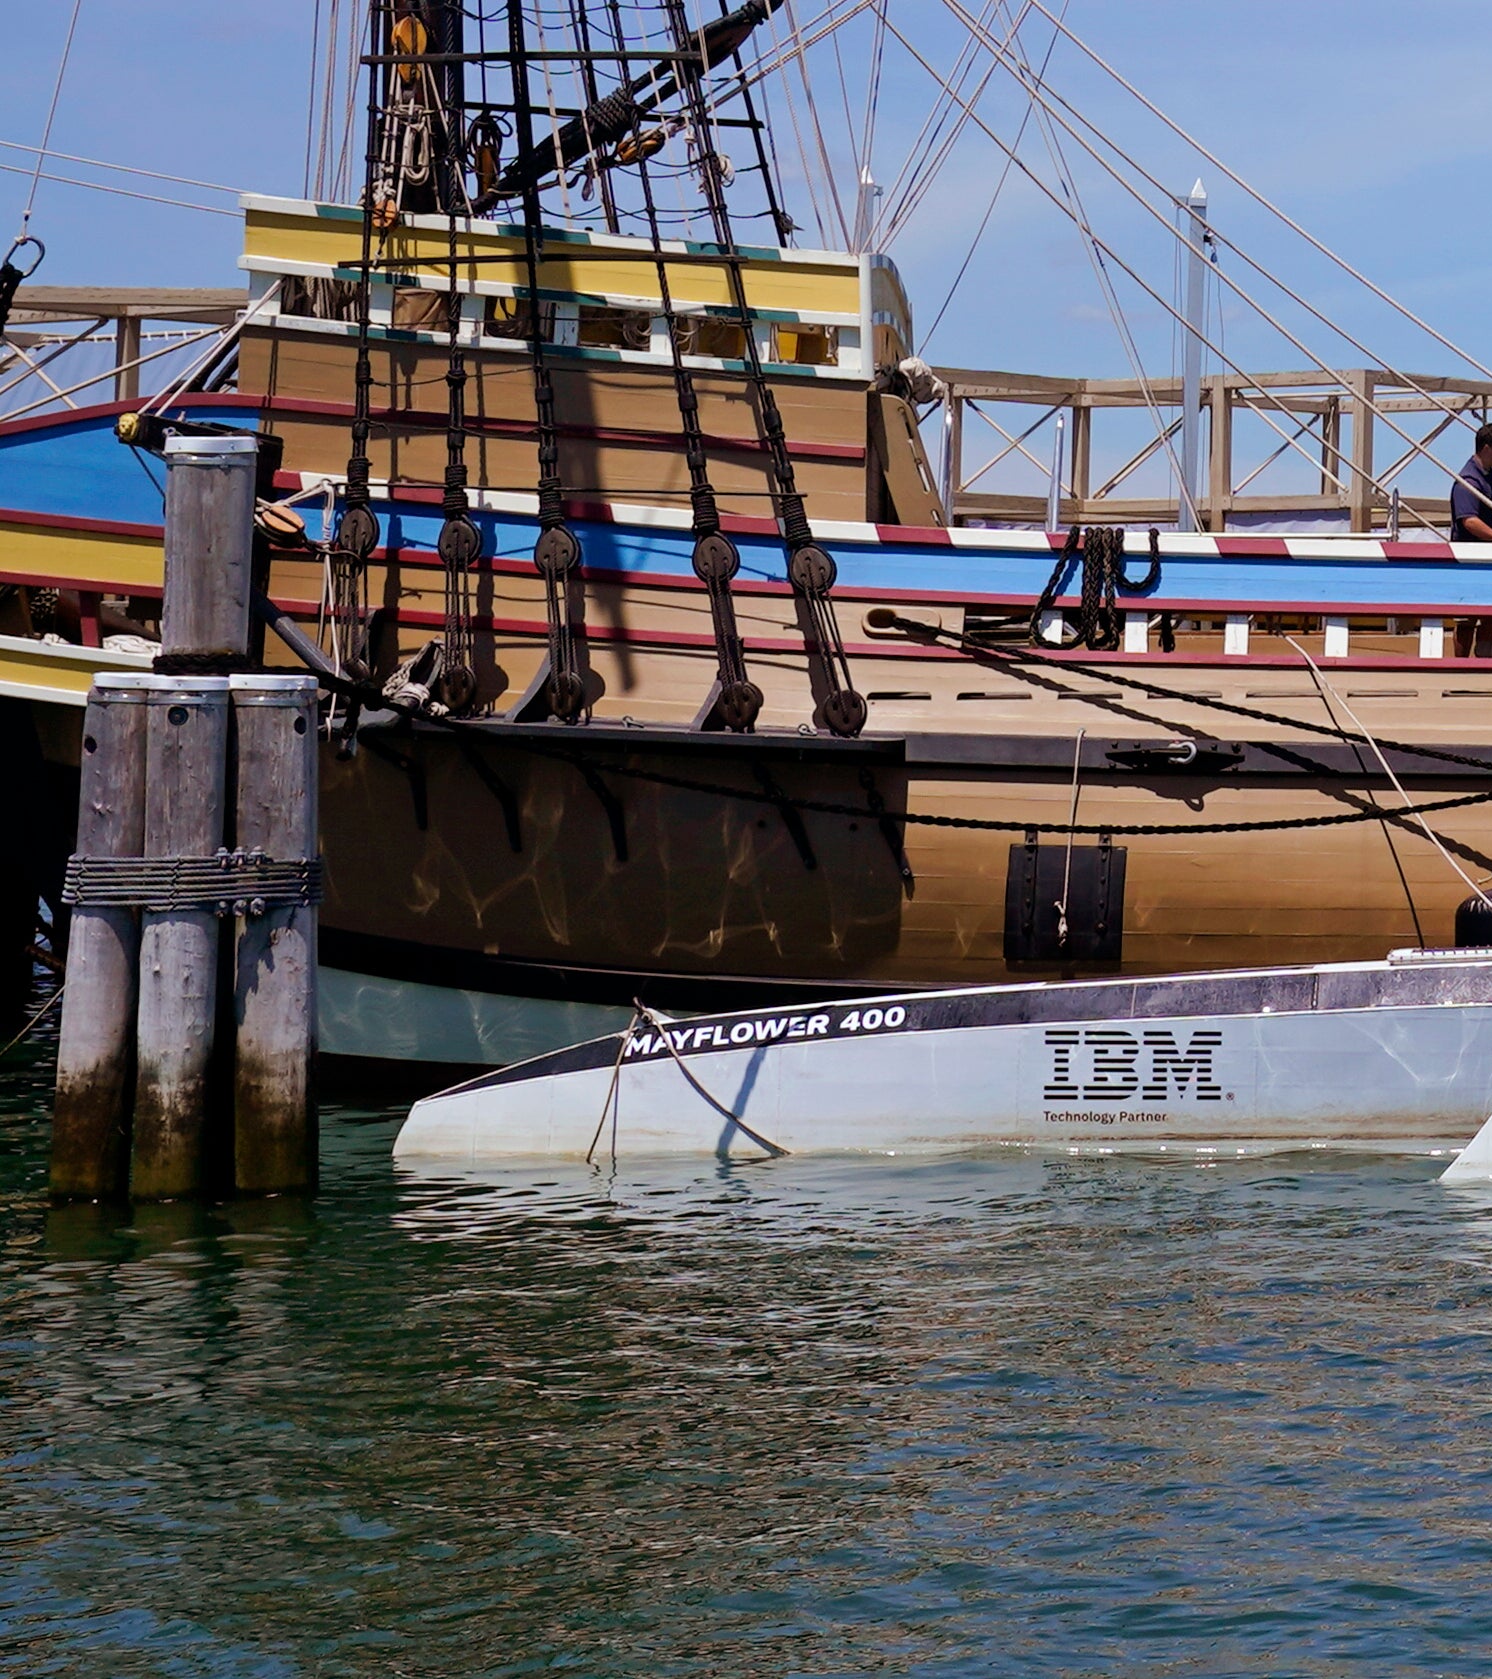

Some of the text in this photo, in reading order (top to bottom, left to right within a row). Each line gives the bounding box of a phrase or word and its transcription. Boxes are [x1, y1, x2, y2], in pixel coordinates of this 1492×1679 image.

[624, 1006, 906, 1057] MAYFLOWER 400
[1043, 1030, 1222, 1100] IBM
[1043, 1111, 1167, 1125] Technology Partner
